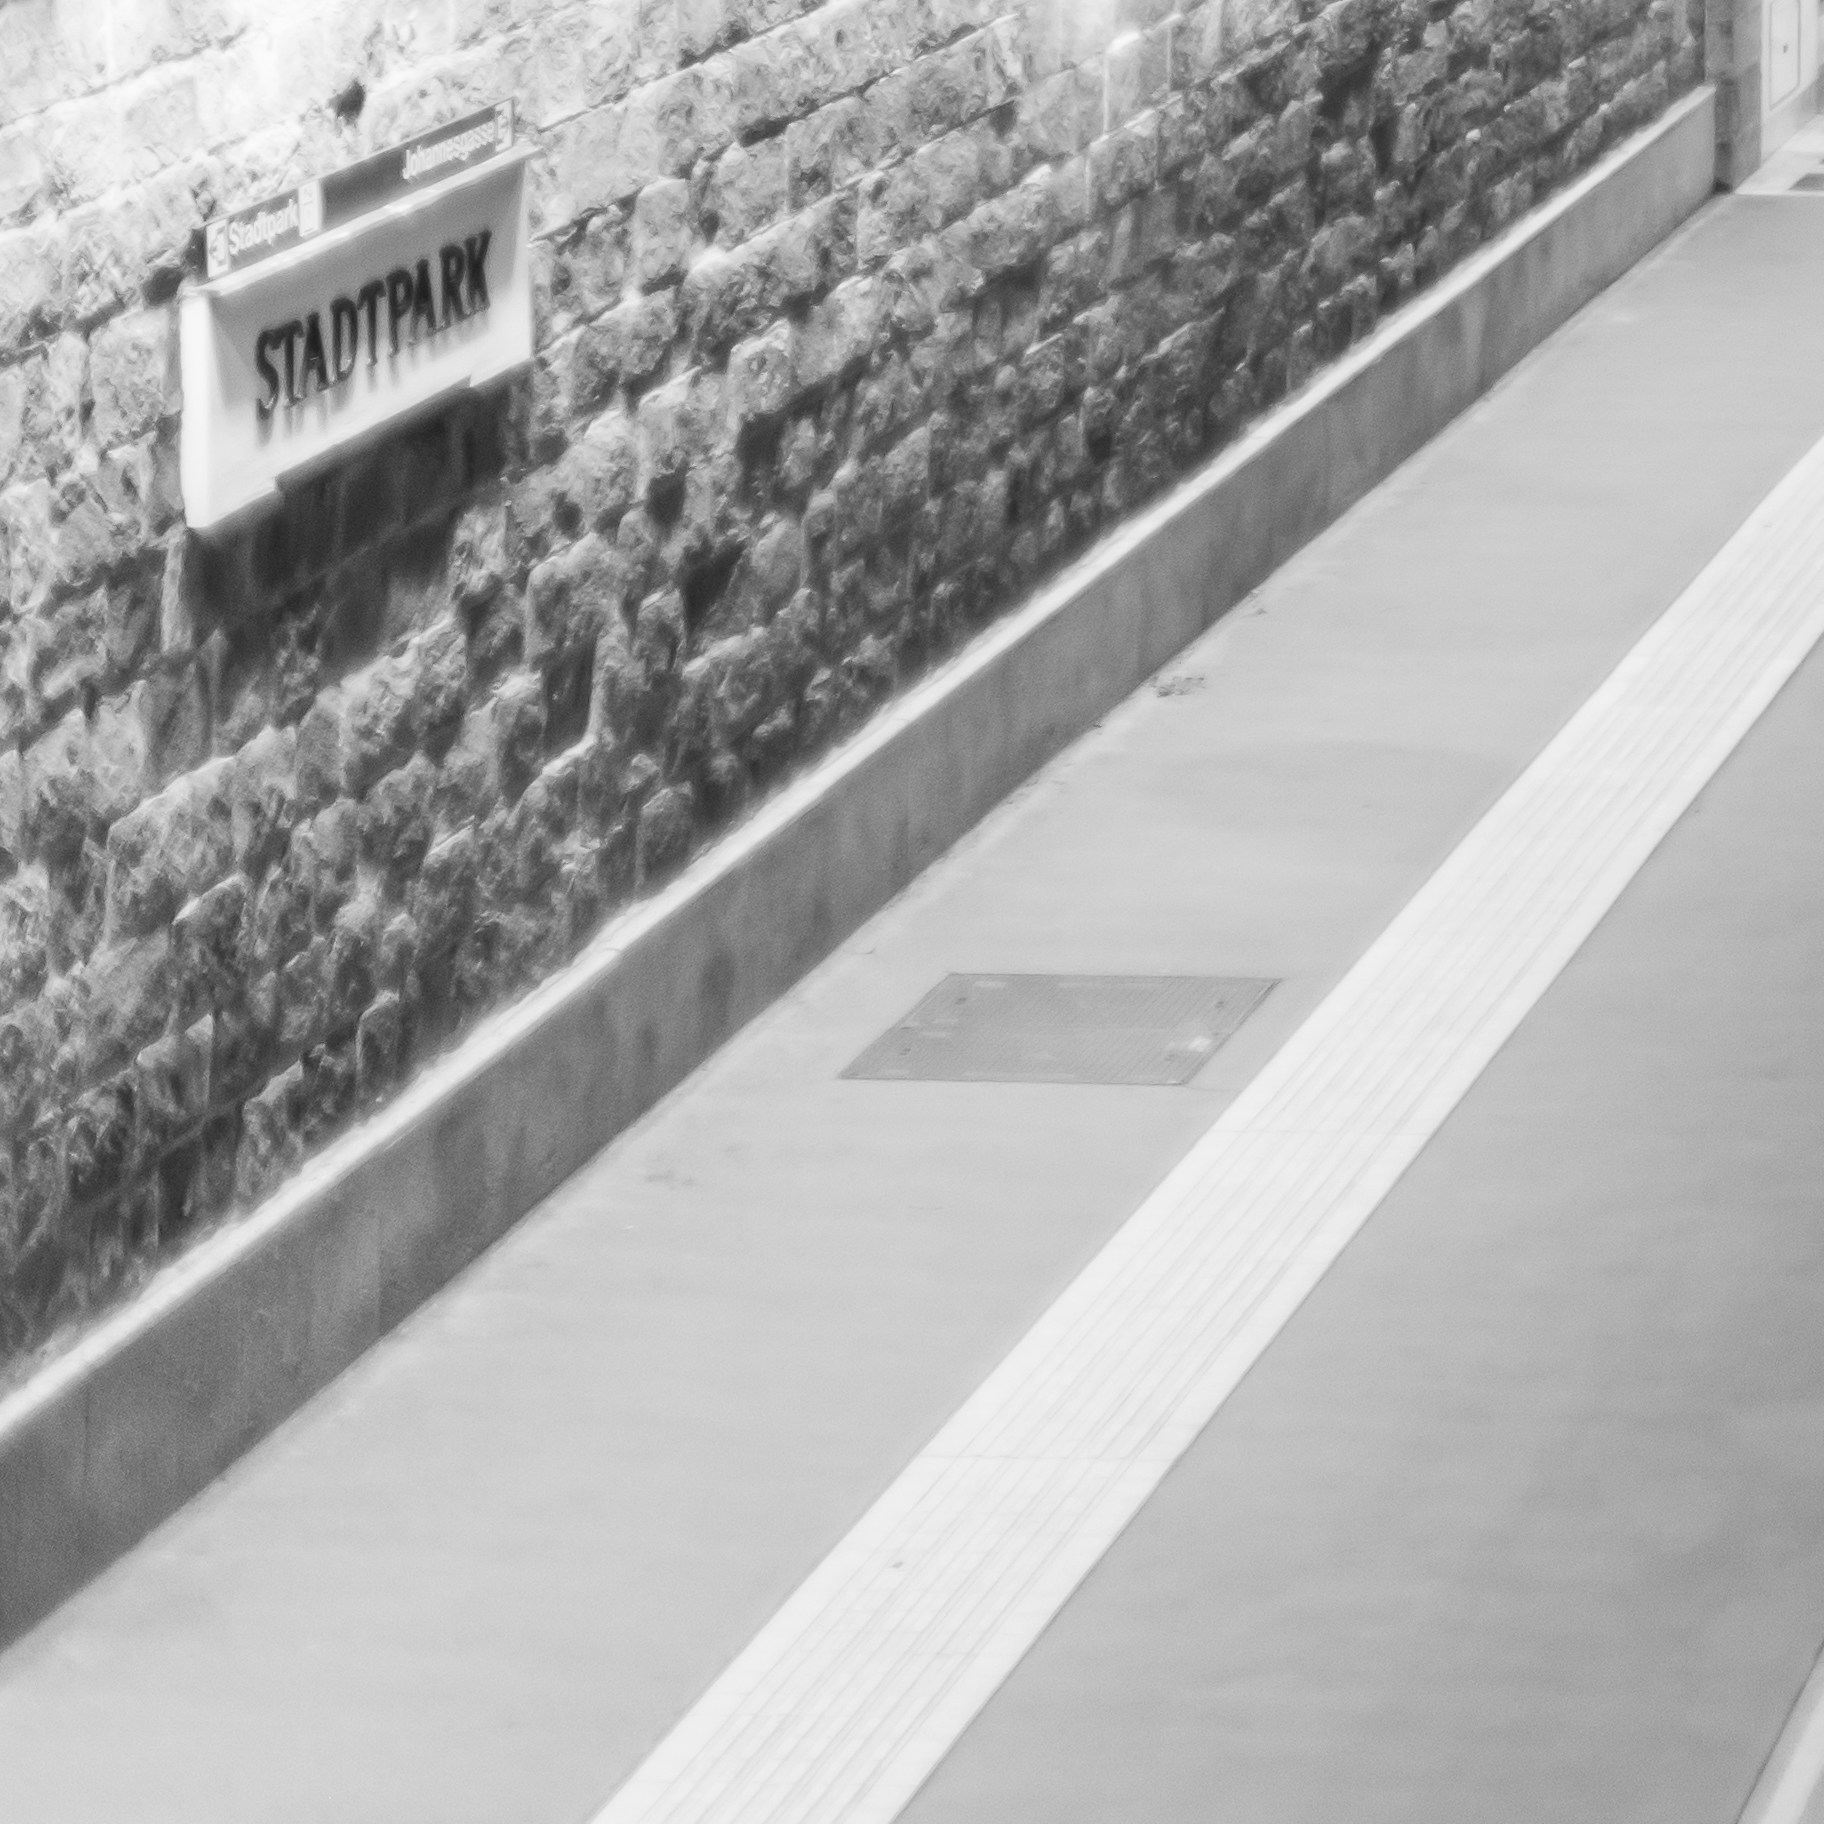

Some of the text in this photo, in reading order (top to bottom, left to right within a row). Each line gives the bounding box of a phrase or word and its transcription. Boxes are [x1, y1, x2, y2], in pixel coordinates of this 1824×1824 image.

[402, 119, 496, 180] Johannesgasse
[229, 198, 300, 256] Stadtpark
[256, 229, 492, 420] STADTPARK
